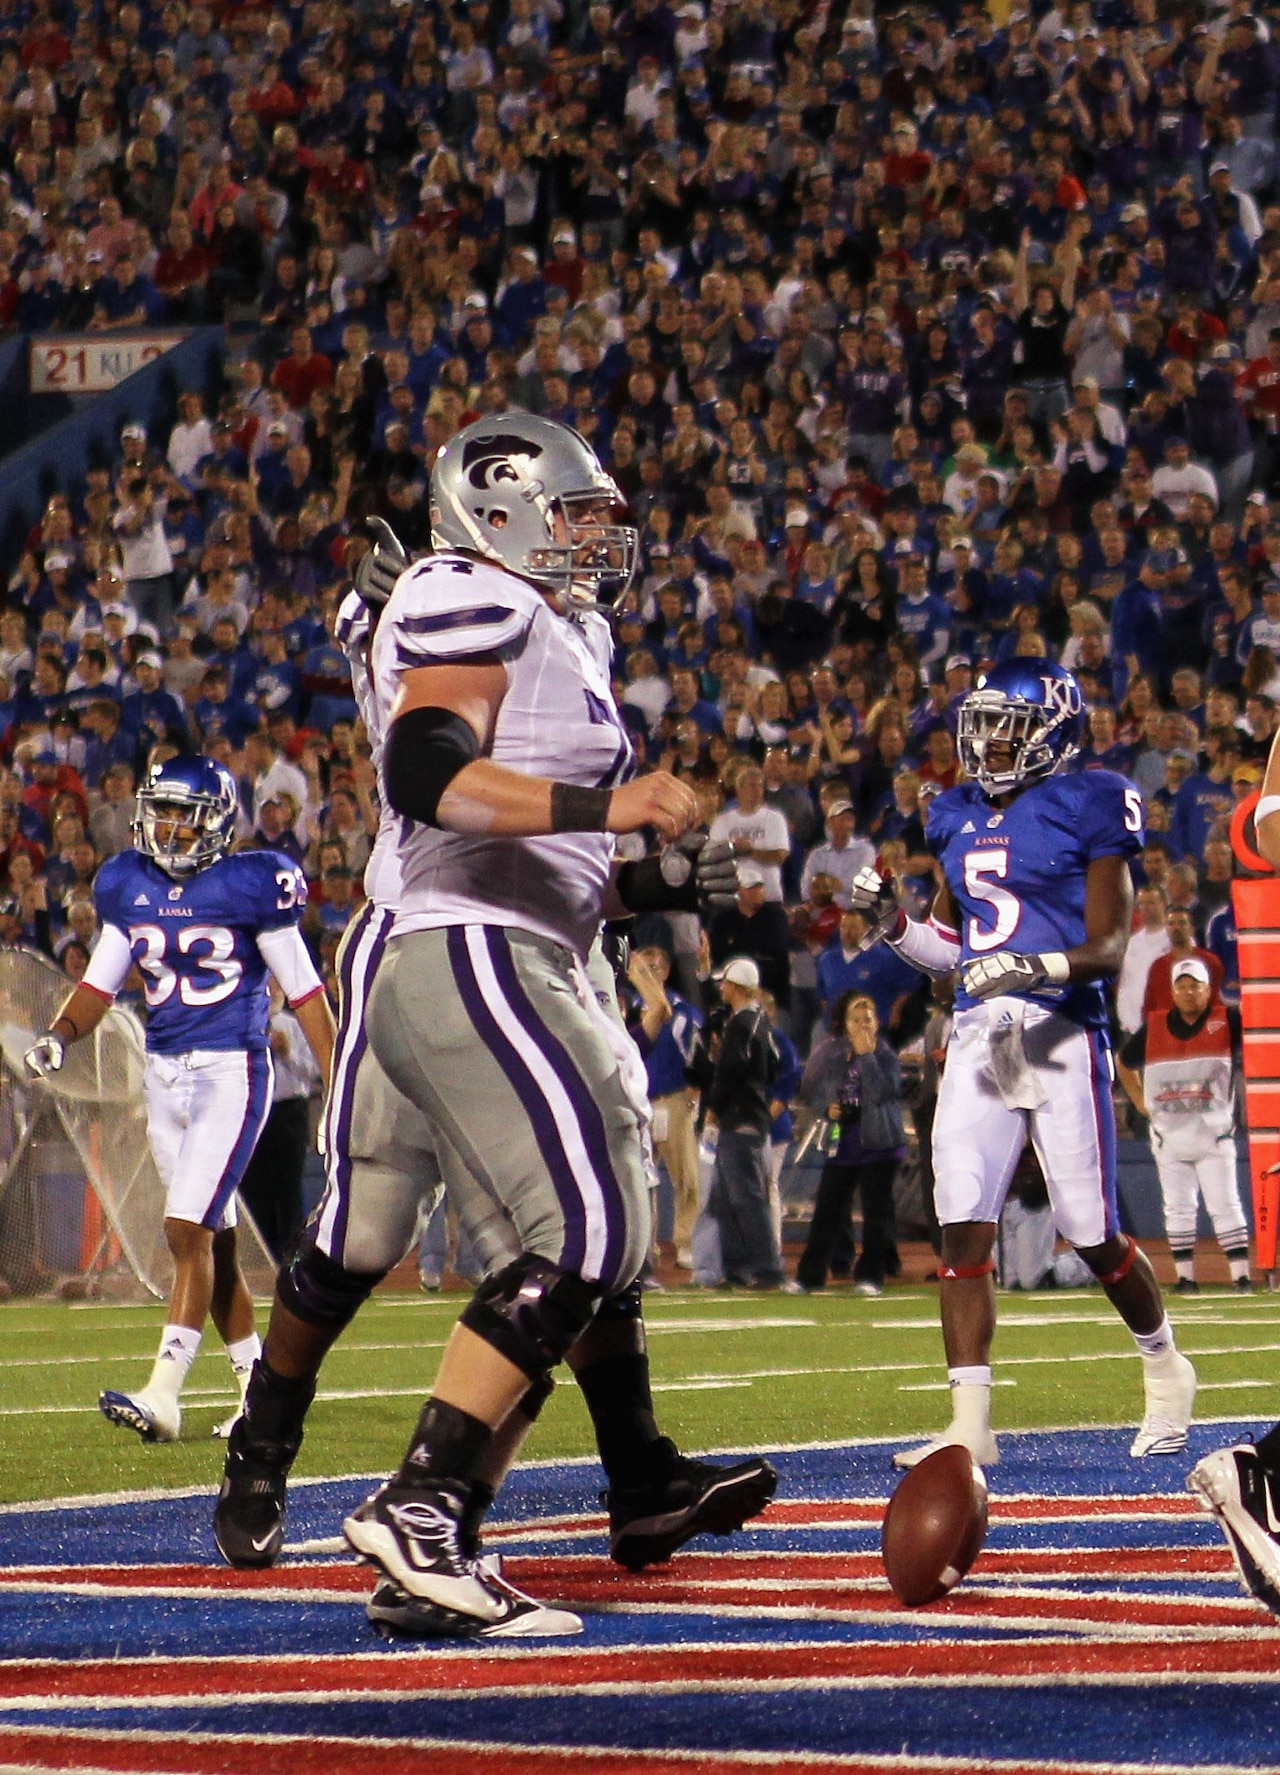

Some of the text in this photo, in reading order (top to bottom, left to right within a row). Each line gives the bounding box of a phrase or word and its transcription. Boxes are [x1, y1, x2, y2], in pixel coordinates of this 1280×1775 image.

[46, 348, 86, 385] 21
[1040, 676, 1081, 719] KU
[1123, 788, 1143, 832] 5
[974, 836, 1010, 846] KANSAS
[157, 907, 194, 918] KANSAS
[964, 850, 1022, 951] 5
[128, 923, 243, 1006] 33
